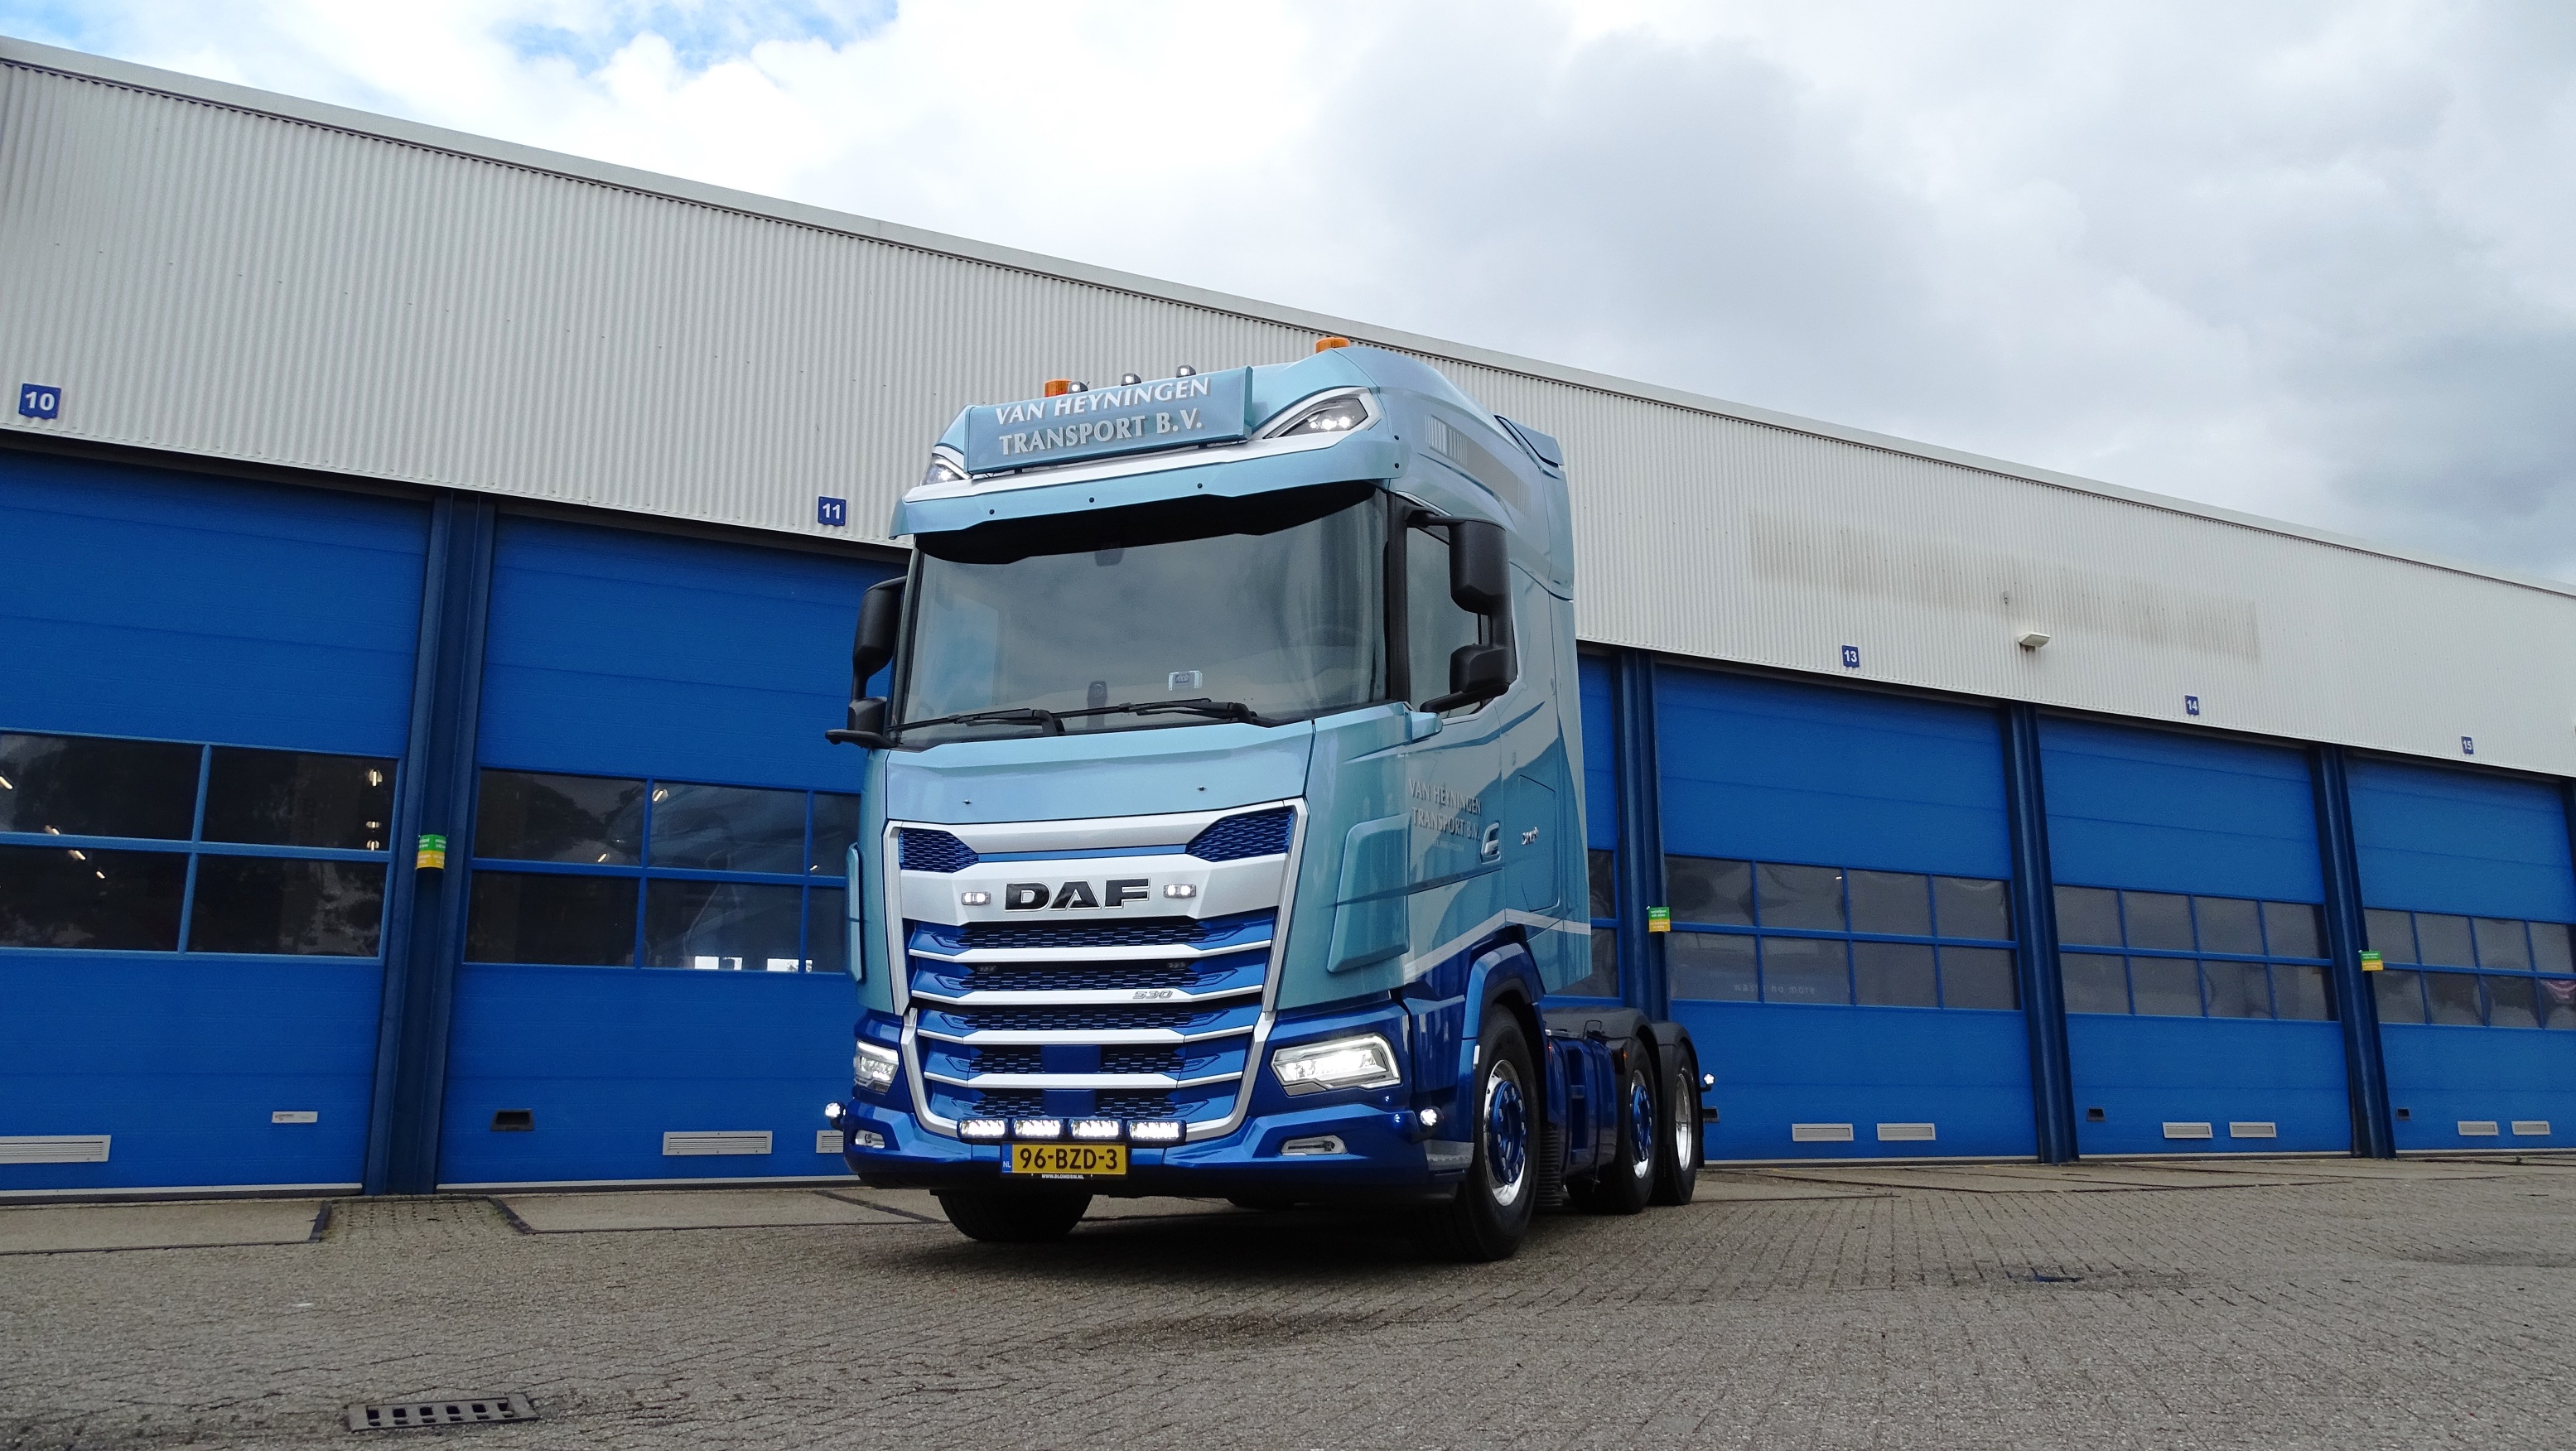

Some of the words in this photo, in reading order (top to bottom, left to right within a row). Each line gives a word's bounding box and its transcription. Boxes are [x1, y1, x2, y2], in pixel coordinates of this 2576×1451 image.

[25, 391, 55, 411] 10
[996, 401, 1046, 425] VAN
[1054, 377, 1211, 417] HEYNINGEN
[999, 415, 1146, 456] TRANSPORT
[822, 503, 841, 519] 11
[1844, 649, 1858, 663] 13
[2187, 699, 2198, 711] 14
[2463, 740, 2472, 750] 15
[1409, 779, 1431, 803] VAN
[1434, 784, 1482, 817] HEYNINGEN
[1411, 806, 1465, 837] TRANSPORT
[1004, 877, 1151, 913] DAF
[1132, 990, 1174, 1000] 530
[1002, 1160, 1012, 1169] NL
[1020, 1147, 1117, 1170] 96-BZD-3
